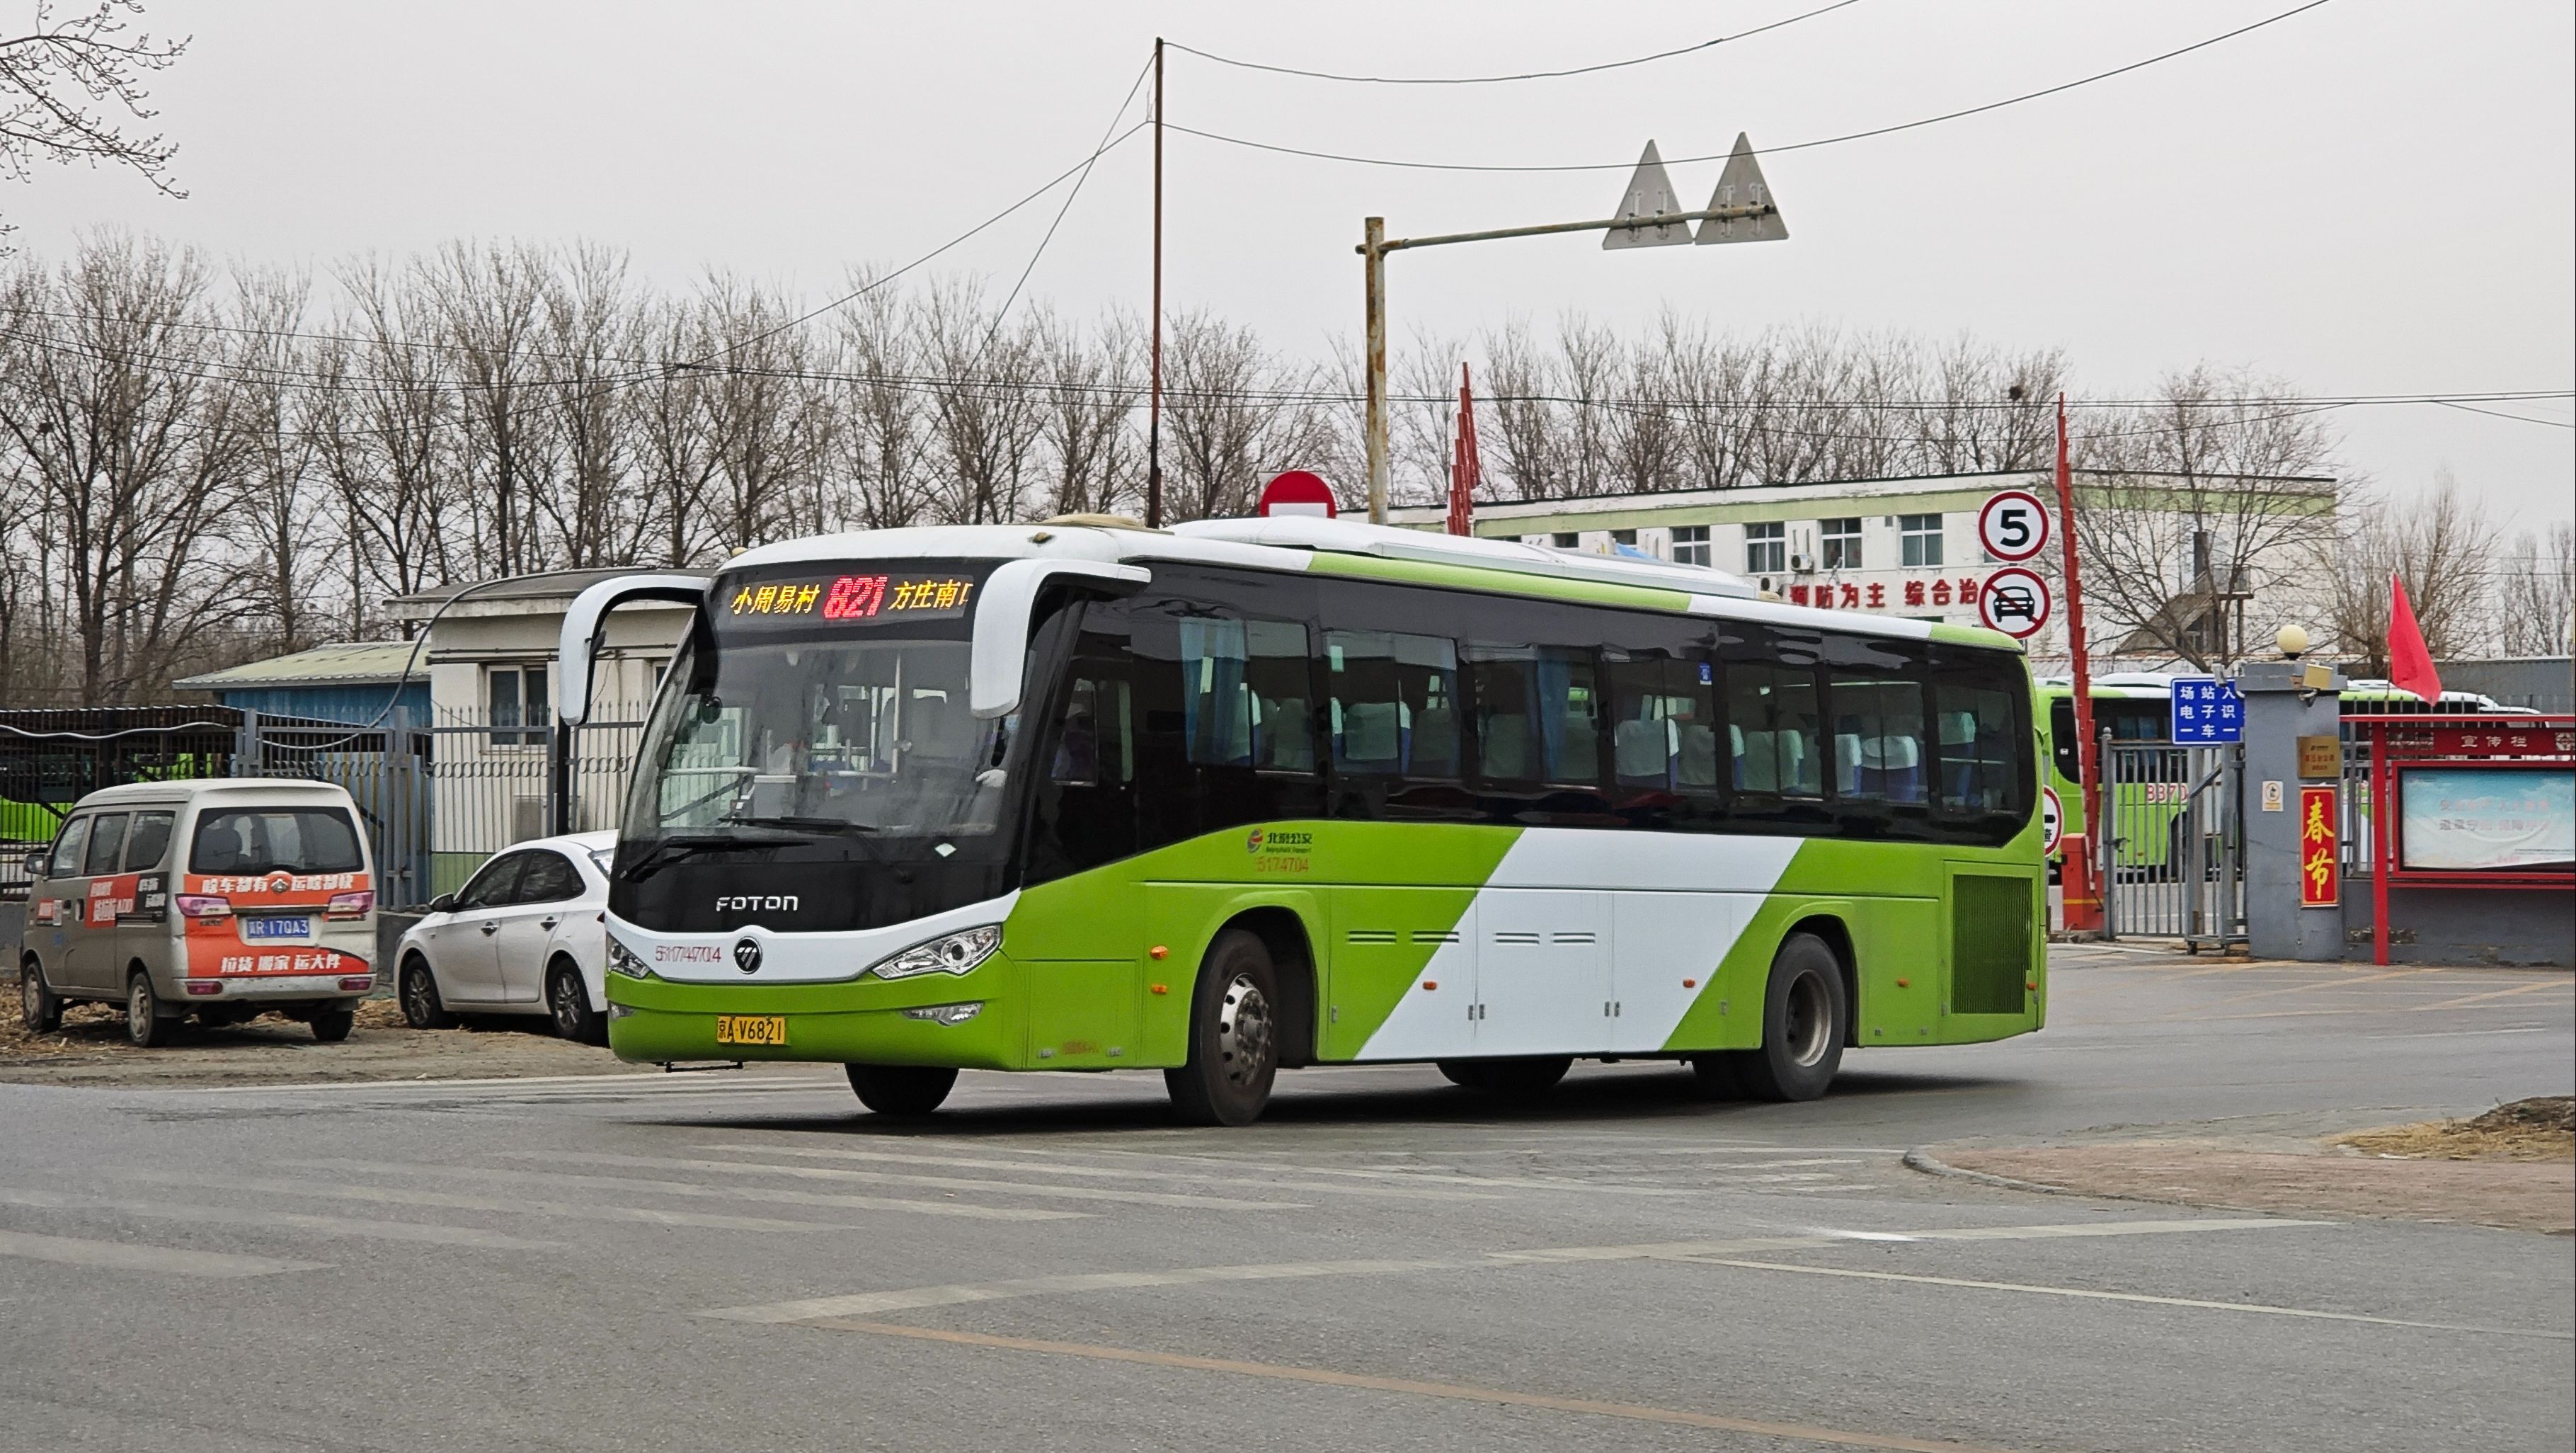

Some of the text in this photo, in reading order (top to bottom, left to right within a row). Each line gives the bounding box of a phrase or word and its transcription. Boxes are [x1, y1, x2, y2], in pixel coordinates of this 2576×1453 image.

[2000, 509, 2030, 547] 5
[731, 583, 820, 615] 小周易村
[823, 575, 888, 619] 821
[1790, 578, 1979, 609] 预防为主 综合治
[2461, 735, 2528, 748] 宣传栏
[2303, 795, 2335, 899] 春节
[716, 896, 798, 911] FOTON
[221, 956, 254, 973] 拉货
